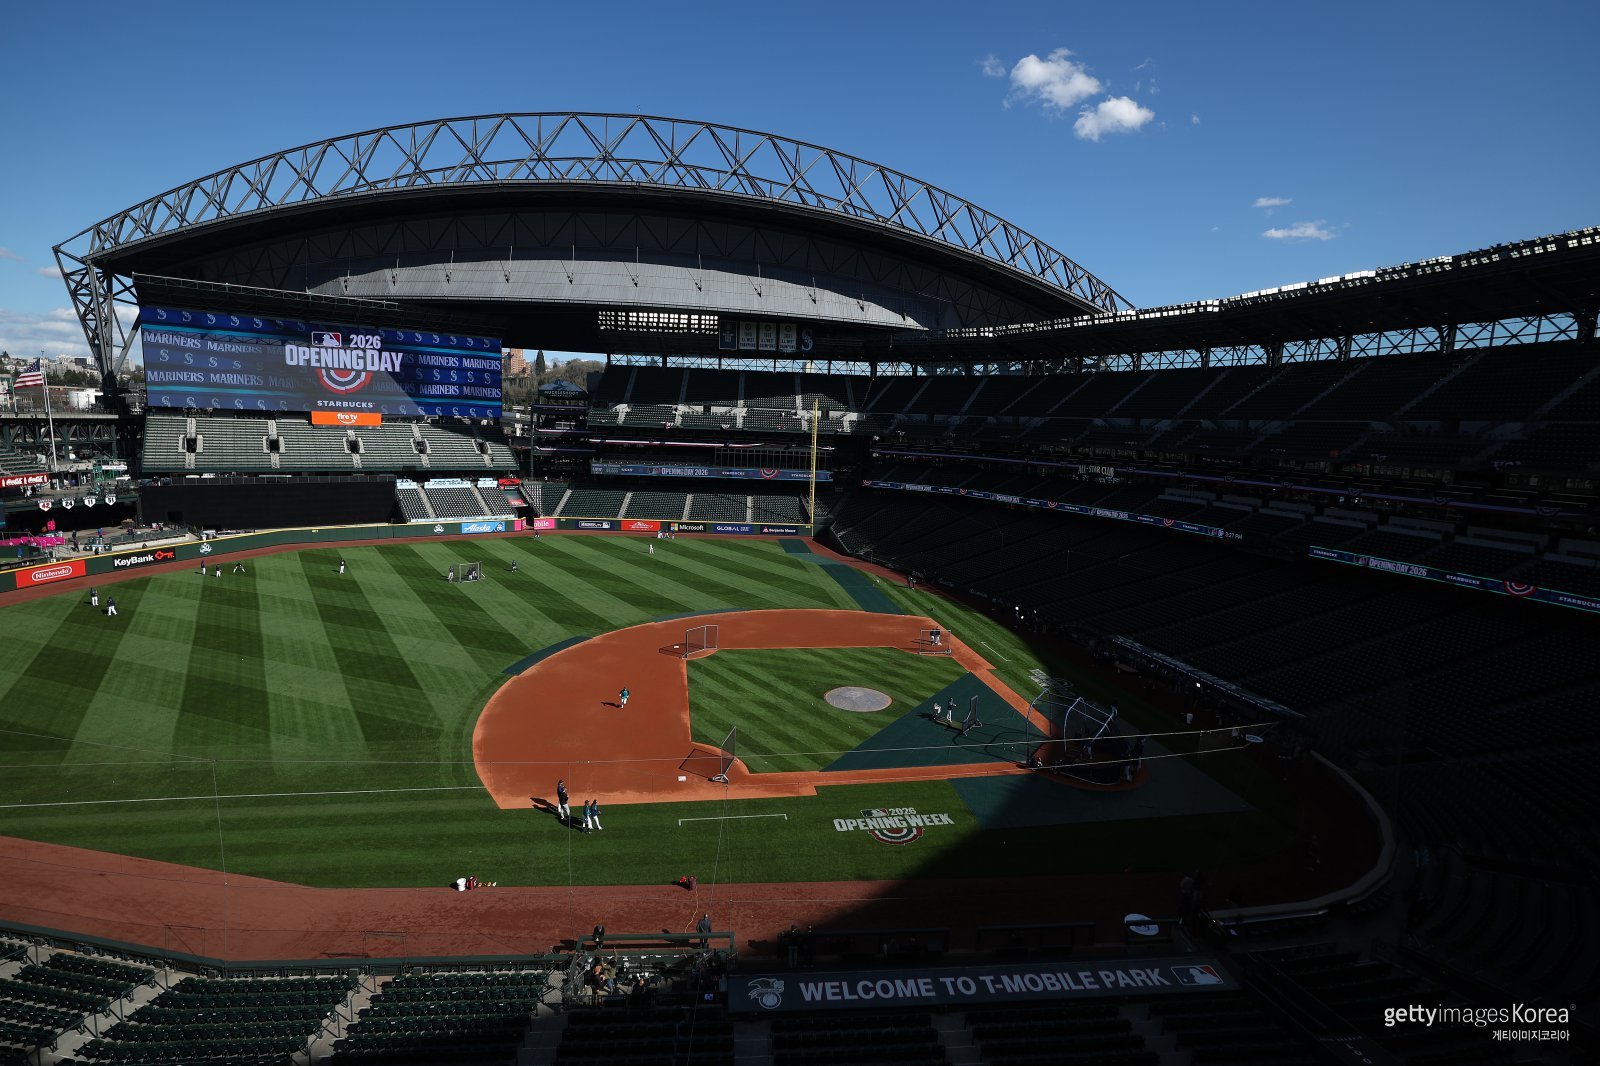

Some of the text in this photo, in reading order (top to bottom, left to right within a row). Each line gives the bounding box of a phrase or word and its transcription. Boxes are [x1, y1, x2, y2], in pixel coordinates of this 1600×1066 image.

[144, 332, 201, 348] MARINERS
[350, 334, 381, 349] 2026
[285, 344, 364, 370] OPENING
[366, 350, 403, 372] DAY
[418, 354, 458, 368] MARINERS
[462, 358, 500, 370] MARINERS
[147, 371, 204, 382] MARINERS
[210, 373, 264, 386] MARINERS
[420, 384, 459, 396] MARINERS
[463, 386, 501, 398] MARINERS
[317, 400, 373, 408] STARBUCKS
[464, 524, 490, 532] Alaska
[114, 554, 154, 566] KeyBank
[1369, 558, 1427, 576] OPENING DAY 2026
[36, 568, 68, 579] Nintendo
[1446, 575, 1480, 585] STARBUCKS
[833, 813, 955, 832] OPENING WEEK
[800, 968, 1171, 1002] WELCOME TO T-MOBILE PARK
